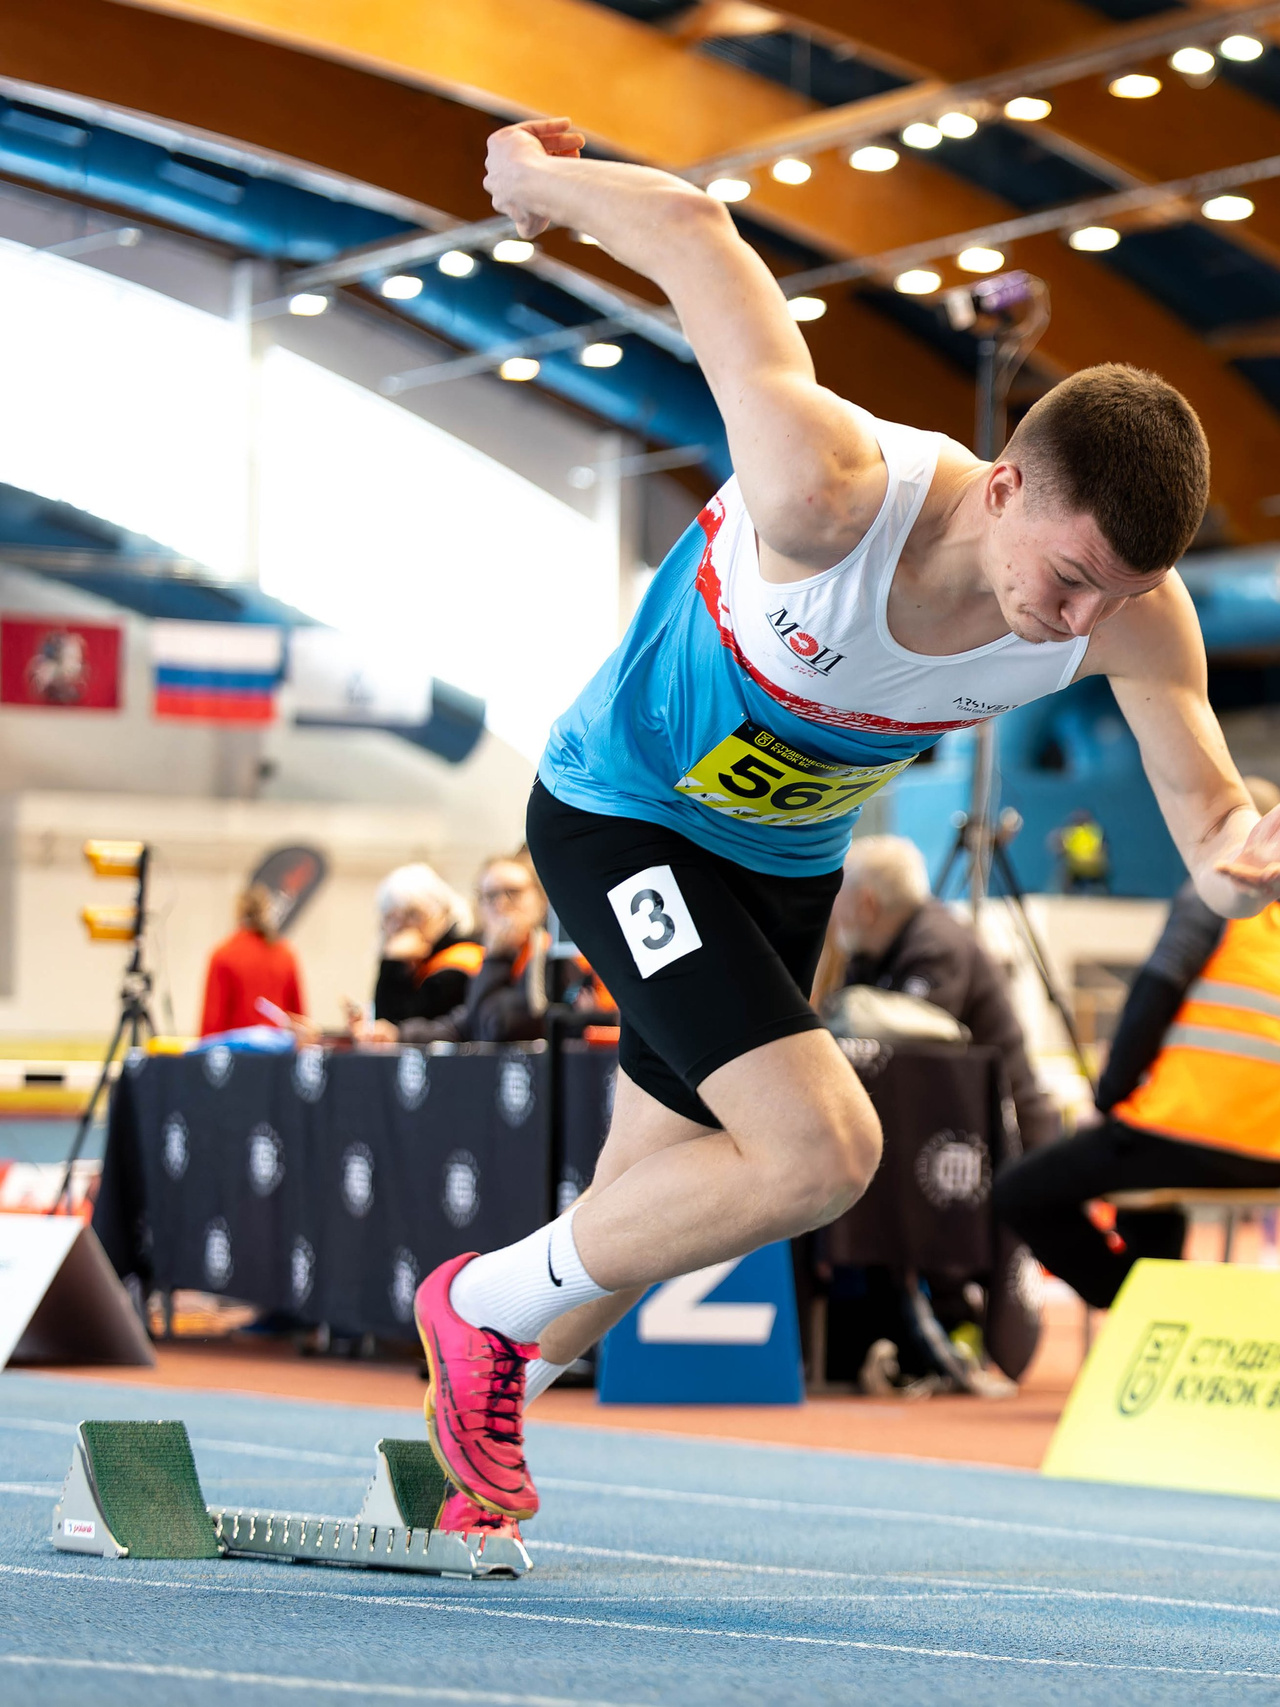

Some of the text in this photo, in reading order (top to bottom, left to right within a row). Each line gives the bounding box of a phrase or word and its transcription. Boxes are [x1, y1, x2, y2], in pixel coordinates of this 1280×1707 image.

[769, 606, 847, 674] МЭИ
[718, 753, 880, 811] 567
[770, 746, 799, 764] КУБОК
[774, 742, 839, 772] СТУДЕНЧЕСКИЙ
[631, 889, 675, 950] 3
